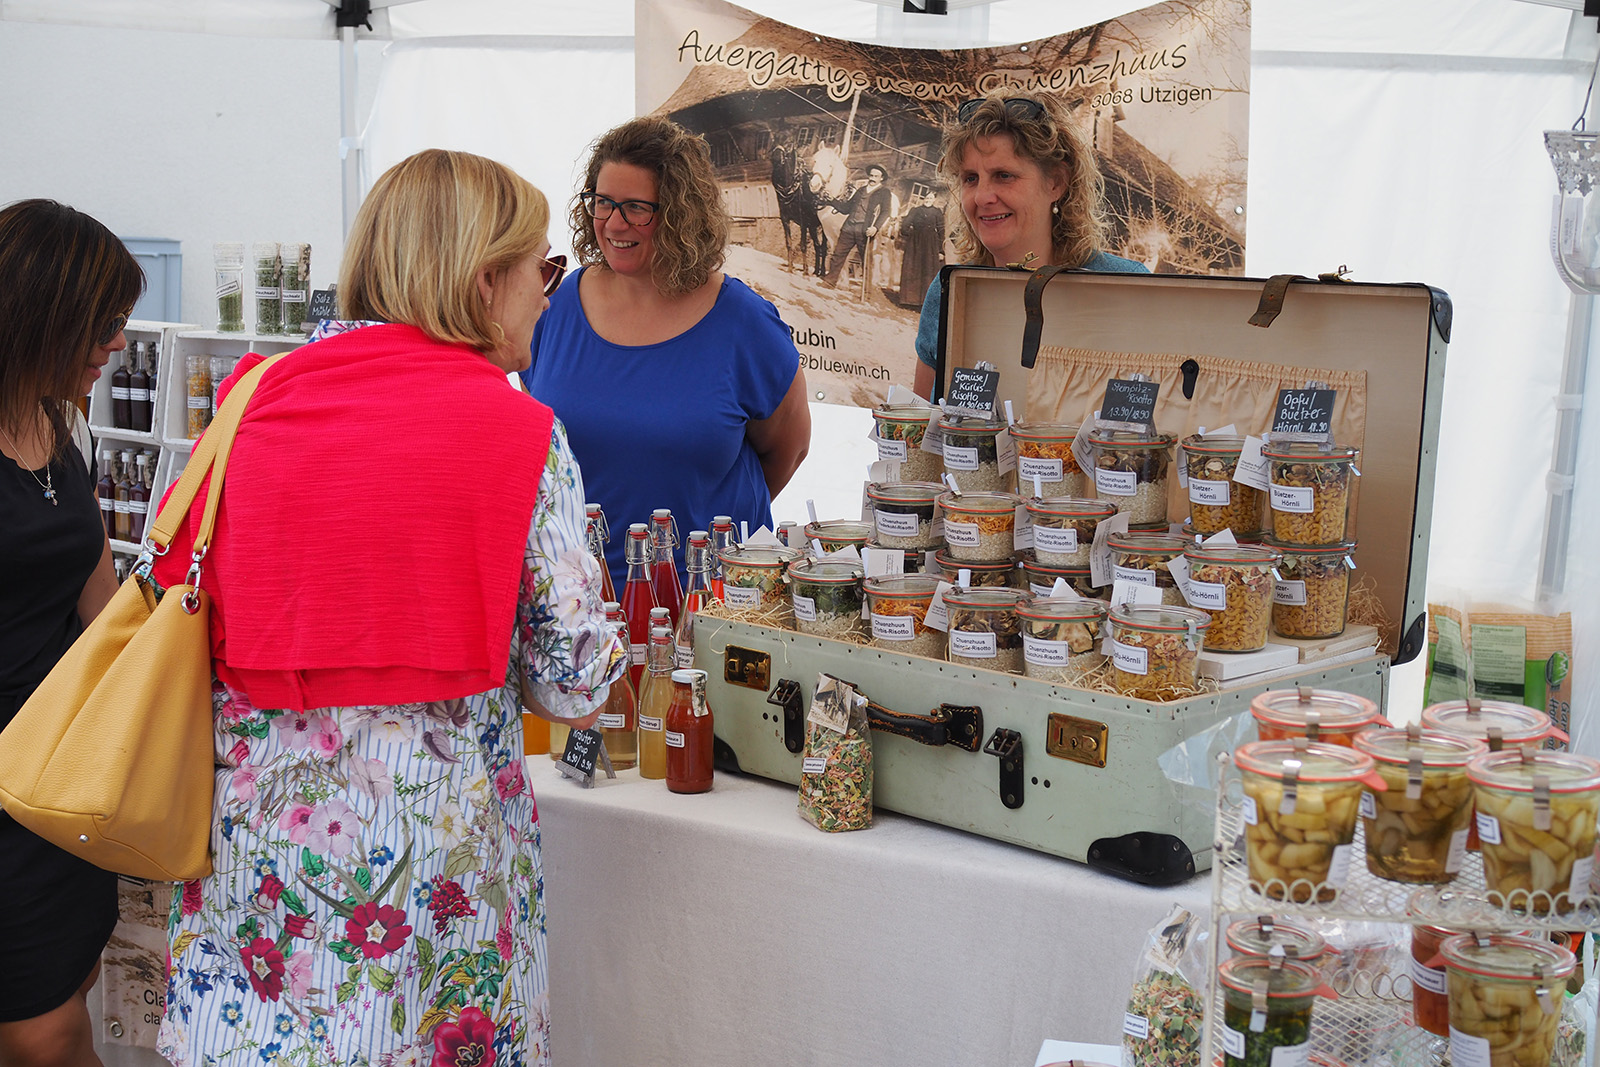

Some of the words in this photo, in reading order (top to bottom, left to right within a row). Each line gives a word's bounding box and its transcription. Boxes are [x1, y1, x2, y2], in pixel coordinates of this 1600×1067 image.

[678, 29, 868, 99] Auergattigs
[879, 77, 968, 98] usem
[1091, 88, 1133, 109] 3068
[1140, 85, 1213, 107] Utzigen
[951, 389, 979, 402] Risotto
[1023, 462, 1055, 470] Chuenzhuus
[1099, 474, 1127, 483] Chuenzhuus
[1199, 492, 1217, 500] Hörnli
[1281, 499, 1300, 507] Hörnli
[1038, 531, 1067, 540] Chuenzhuus
[1116, 571, 1147, 582] Chuenzhuus
[875, 620, 905, 629] Chuenzhuus
[956, 637, 985, 645] Chuenzhuus
[1028, 645, 1058, 654] Chuenzhuus
[143, 990, 165, 1008] Cla
